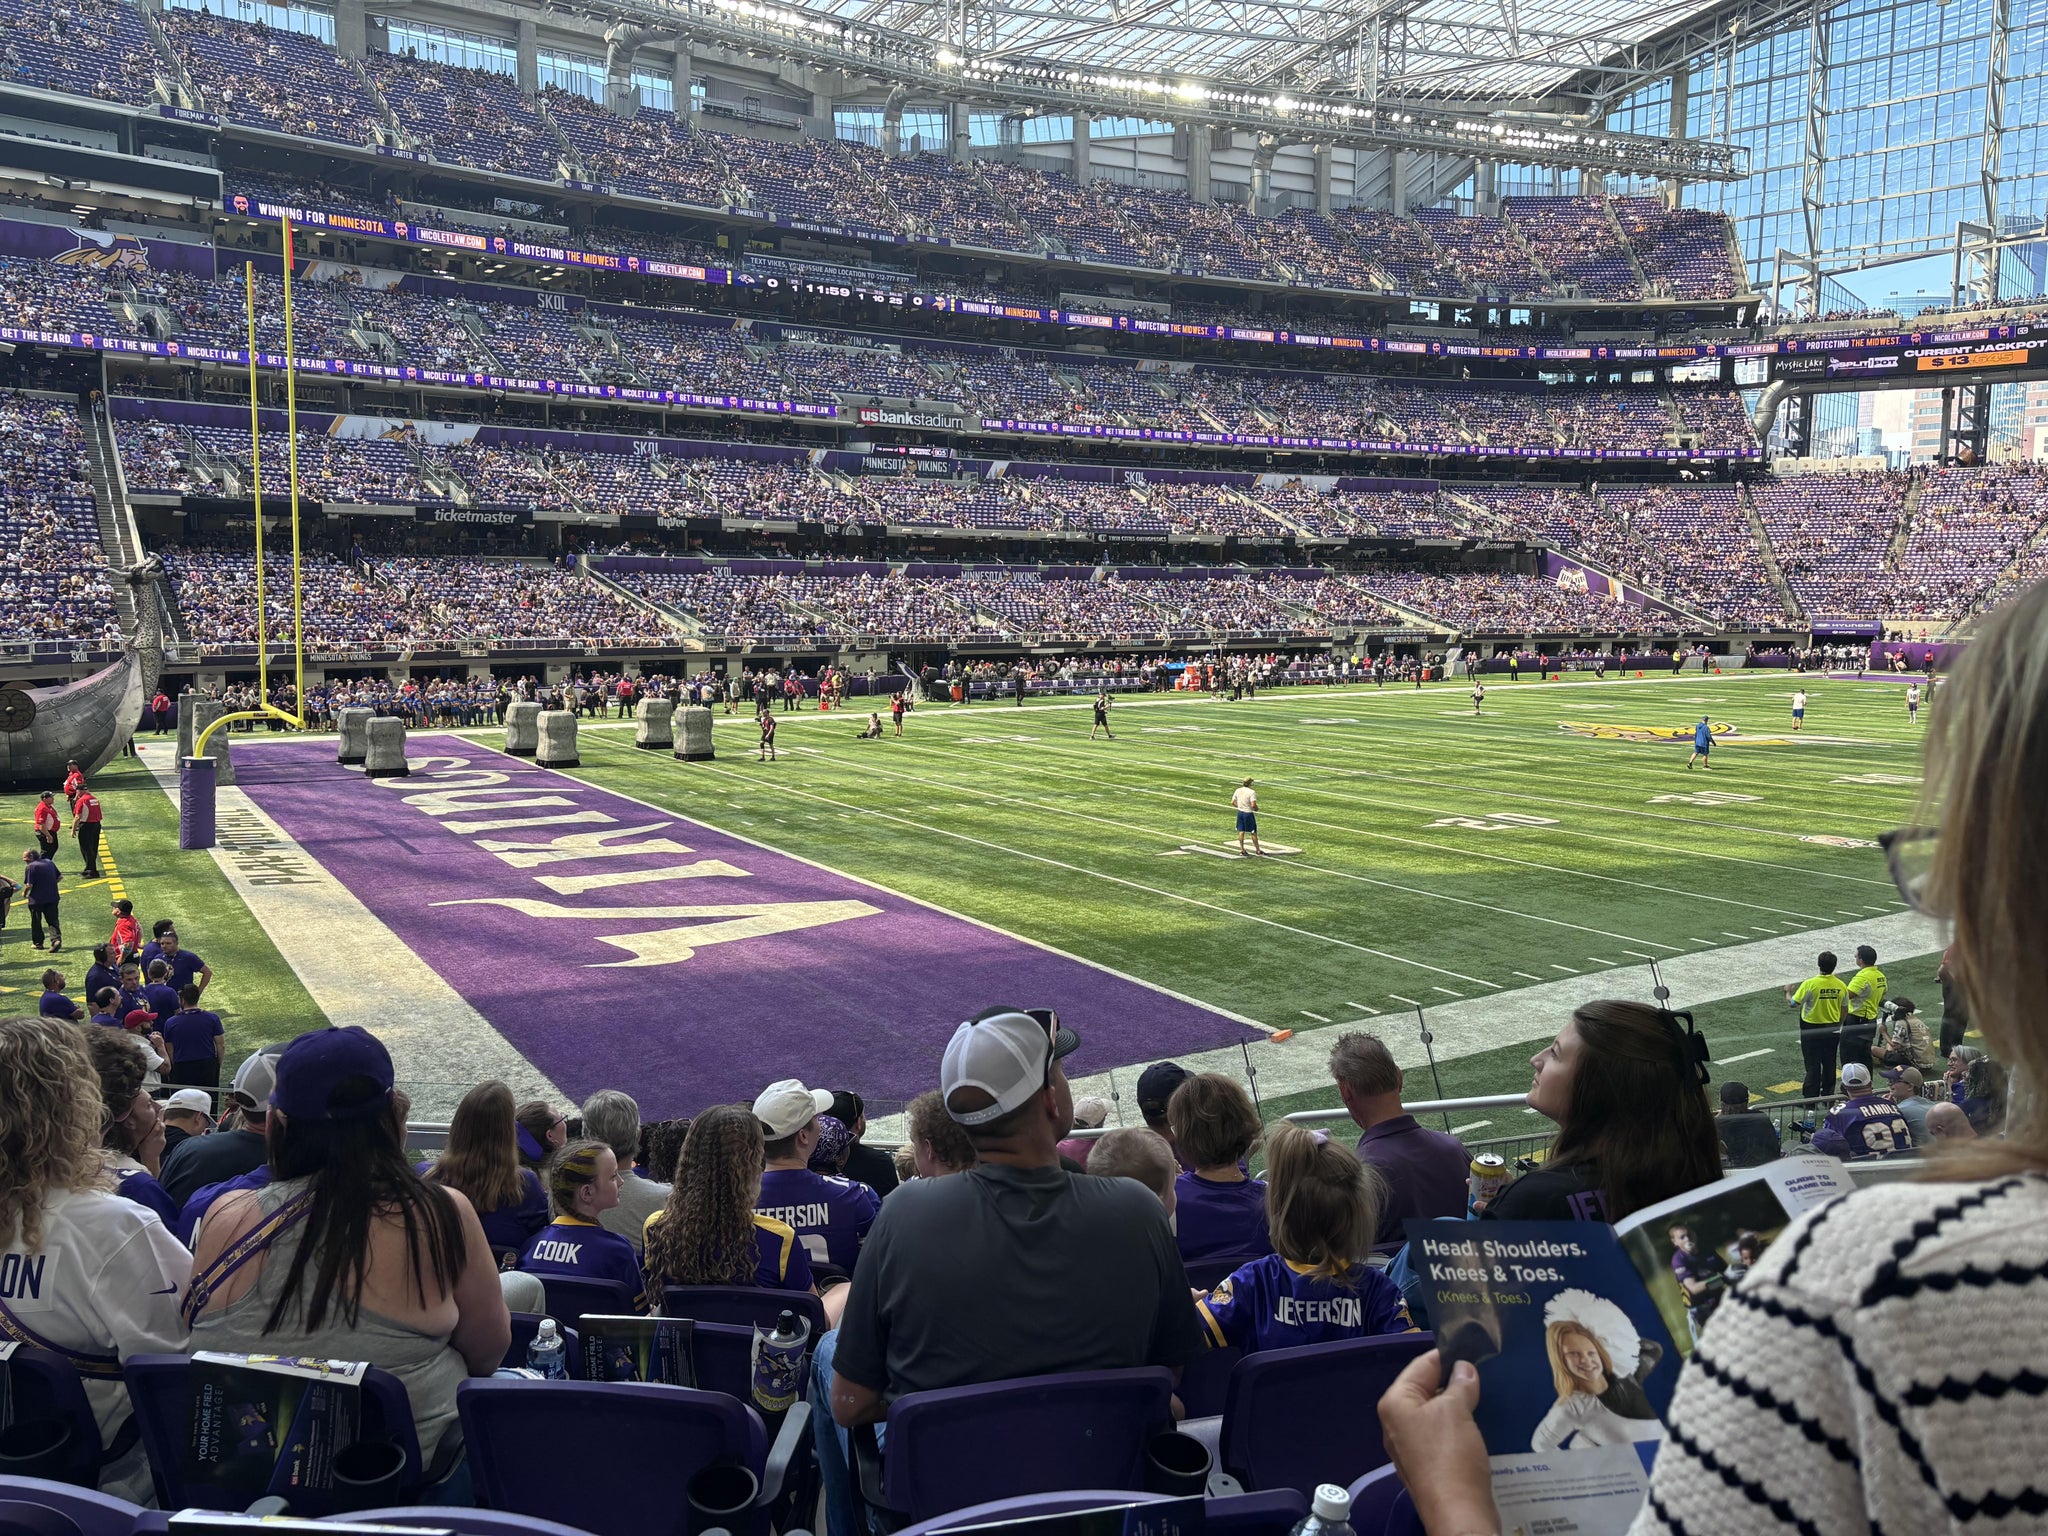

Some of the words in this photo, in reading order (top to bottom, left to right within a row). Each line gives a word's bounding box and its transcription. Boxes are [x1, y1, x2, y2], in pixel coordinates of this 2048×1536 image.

[175, 109, 205, 121] FOREMAN
[209, 115, 219, 123] 44
[392, 149, 413, 160] CARTER
[581, 183, 594, 191] YARY
[600, 186, 609, 194] 73
[258, 202, 303, 222] WINNING
[305, 210, 326, 225] FOR
[328, 214, 387, 236] MINNESOTA.
[791, 221, 820, 231] MINNESOTA
[822, 226, 842, 235] VIKINGS
[420, 229, 483, 249] NICOLETLAW.COM
[514, 243, 564, 261] PROTECTING
[566, 251, 581, 263] THE
[583, 252, 621, 268] MIDWEST.
[750, 257, 767, 266] TEXT
[650, 263, 703, 279] NICOLETLAW.COM
[806, 284, 851, 298] 11:59
[537, 292, 569, 311] SKOL
[888, 297, 903, 305] 25
[962, 301, 990, 314] WINNING
[991, 305, 1004, 316] FOR
[1005, 306, 1042, 320] MINNESOTA.
[1135, 319, 1170, 332] PROTECTING
[1170, 323, 1181, 333] THE
[1181, 324, 1210, 337] MIDWEST.
[1, 328, 20, 339] GET
[22, 330, 39, 341] THE
[41, 332, 73, 344] BEARD.
[1295, 334, 1320, 345] WINNING
[1321, 336, 1331, 346] FOR
[1333, 337, 1364, 349] MINNESOTA.
[1806, 339, 1849, 350] PROTECTING
[1851, 338, 1865, 348] THE
[1866, 336, 1902, 347] MIDWEST.
[1934, 330, 1985, 343] NICOLETLAW.COM
[103, 338, 120, 348] GET
[122, 340, 138, 350] THE
[140, 342, 159, 353] WIN.
[1447, 345, 1480, 355] PROTECTING
[1481, 347, 1491, 356] THE
[1492, 347, 1520, 357] MIDWEST.
[1615, 349, 1643, 357] WINNING
[1644, 348, 1657, 357] FOR
[1659, 347, 1698, 357] MINNESOTA.
[1727, 344, 1776, 355] NICOLETLAW.COM
[1904, 346, 1973, 358] CURRENT
[1975, 339, 2048, 353] JACKPOT
[187, 346, 220, 359] NICOLET
[222, 350, 240, 360] LAW.
[267, 354, 283, 365] GET
[301, 358, 328, 370] BEARD.
[1838, 360, 1869, 368] SPLIT
[353, 363, 367, 373] GET
[369, 365, 382, 375] THE
[384, 366, 400, 377] WIN.
[423, 371, 450, 381] NICOLET
[452, 373, 468, 383] LAW.
[490, 376, 502, 386] GET
[504, 378, 516, 387] THE
[518, 379, 541, 390] BEARD.
[562, 383, 574, 392] GET
[575, 384, 587, 393] THE
[588, 385, 602, 395] WIN.
[622, 389, 643, 399] NICOLET
[645, 391, 661, 400] LAW.
[680, 393, 691, 402] GET
[692, 394, 703, 403] THE
[704, 395, 725, 405] BEARD.
[743, 399, 754, 408] GET
[755, 400, 765, 409] THE
[766, 401, 779, 410] WIN.
[796, 403, 816, 412] NICOLET
[817, 404, 831, 414] LAW.
[1018, 422, 1028, 430] GET
[1028, 422, 1038, 430] THE
[633, 440, 659, 456] SKOL
[862, 456, 907, 471] MINNESOTA
[918, 459, 948, 473] VIKINGS
[1124, 471, 1146, 483] SKOL
[434, 508, 517, 524] ticketmaster
[824, 523, 840, 535] Lite
[712, 565, 732, 578] SKOL
[961, 570, 1003, 582] MINNESOTA
[1012, 570, 1041, 582] VIKINGS
[71, 652, 90, 663] SKOL
[310, 653, 343, 662] MINNESOTA
[349, 653, 372, 662] VIKINGS
[584, 648, 599, 656] SKOL
[1435, 812, 1560, 831] 20
[1180, 838, 1303, 860] 10
[344, 756, 885, 968] VIKINGS
[1785, 1176, 1816, 1187] GUIDE
[1789, 1183, 1820, 1193] GAME
[751, 1203, 829, 1228] FERSON
[532, 1240, 583, 1265] COOK
[1422, 1238, 1479, 1258] Head.
[1482, 1239, 1588, 1260] Shoulders.
[0, 1253, 47, 1300] ON
[1429, 1263, 1489, 1282] Knees
[1493, 1264, 1508, 1282] &
[1510, 1265, 1565, 1283] Toes.
[1436, 1290, 1480, 1304] (Knees
[1481, 1291, 1491, 1305] &
[1494, 1291, 1532, 1306] Toes.)
[588, 1336, 596, 1355] FIELD
[589, 1356, 598, 1378] HOME
[203, 1383, 213, 1409] FIELD
[201, 1410, 211, 1434] HOME
[198, 1436, 209, 1461] YOUR
